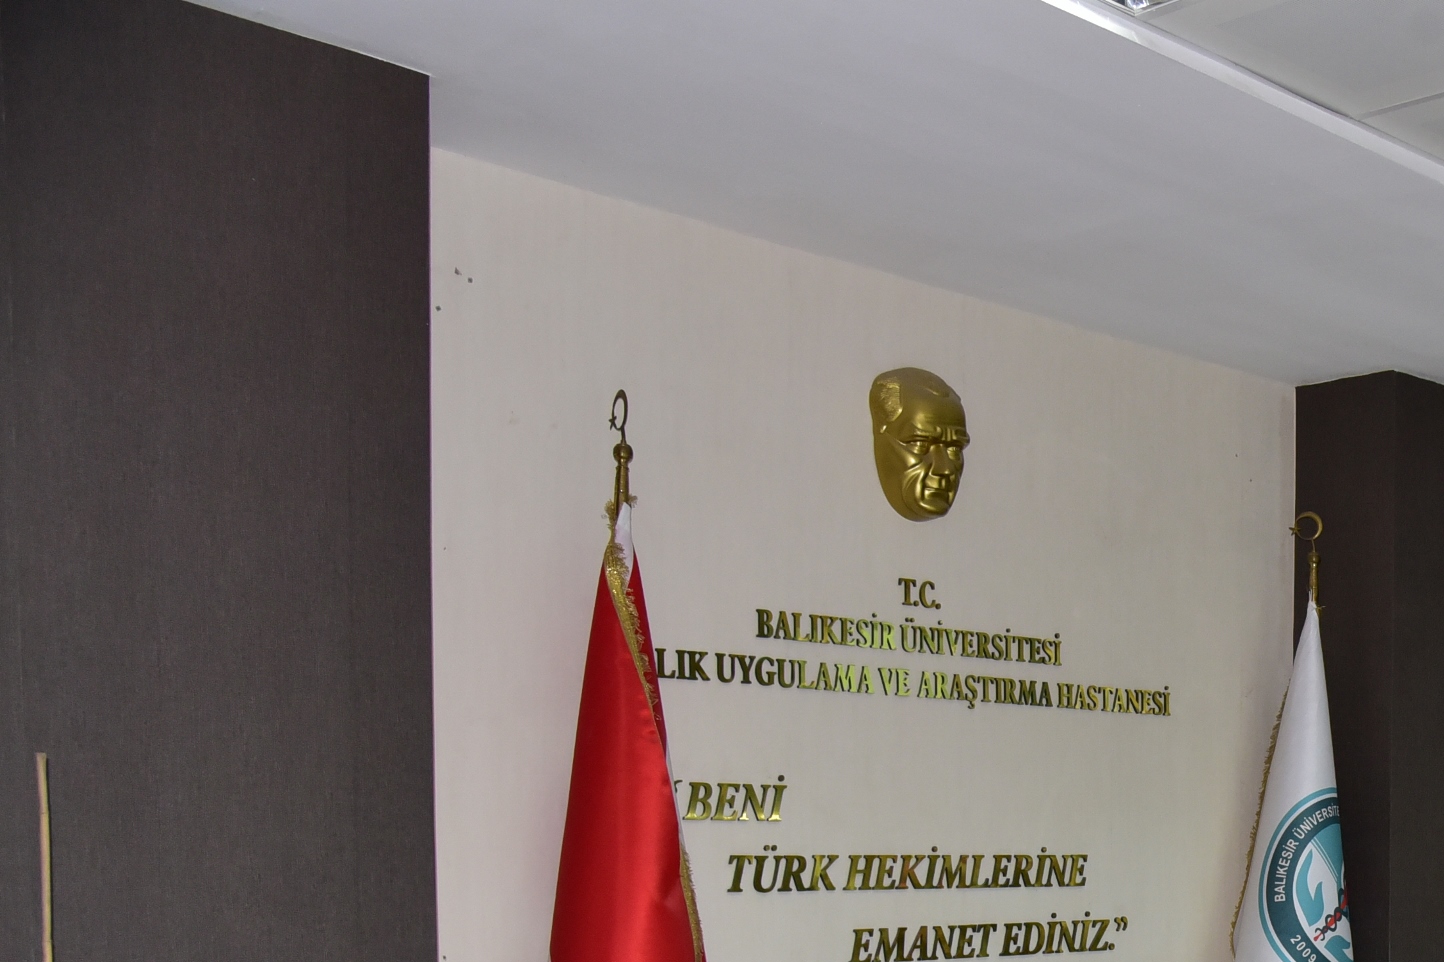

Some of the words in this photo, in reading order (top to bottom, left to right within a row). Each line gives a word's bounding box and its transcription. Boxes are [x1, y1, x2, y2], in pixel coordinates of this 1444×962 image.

[898, 577, 942, 610] T.C.
[755, 608, 895, 651] BALIKESİR
[899, 616, 1063, 667] ÜNİVERSİTESİ
[655, 648, 711, 682] LIK
[714, 652, 875, 696] UYGULAMA
[879, 667, 911, 697] VE
[917, 670, 1054, 711] ARAŞTIRMA
[1056, 682, 1172, 717] HASTANESİ
[727, 844, 837, 893] TÜRK
[843, 845, 1089, 892] HEKİMLERİNE
[1274, 839, 1300, 903] BALIKESİR
